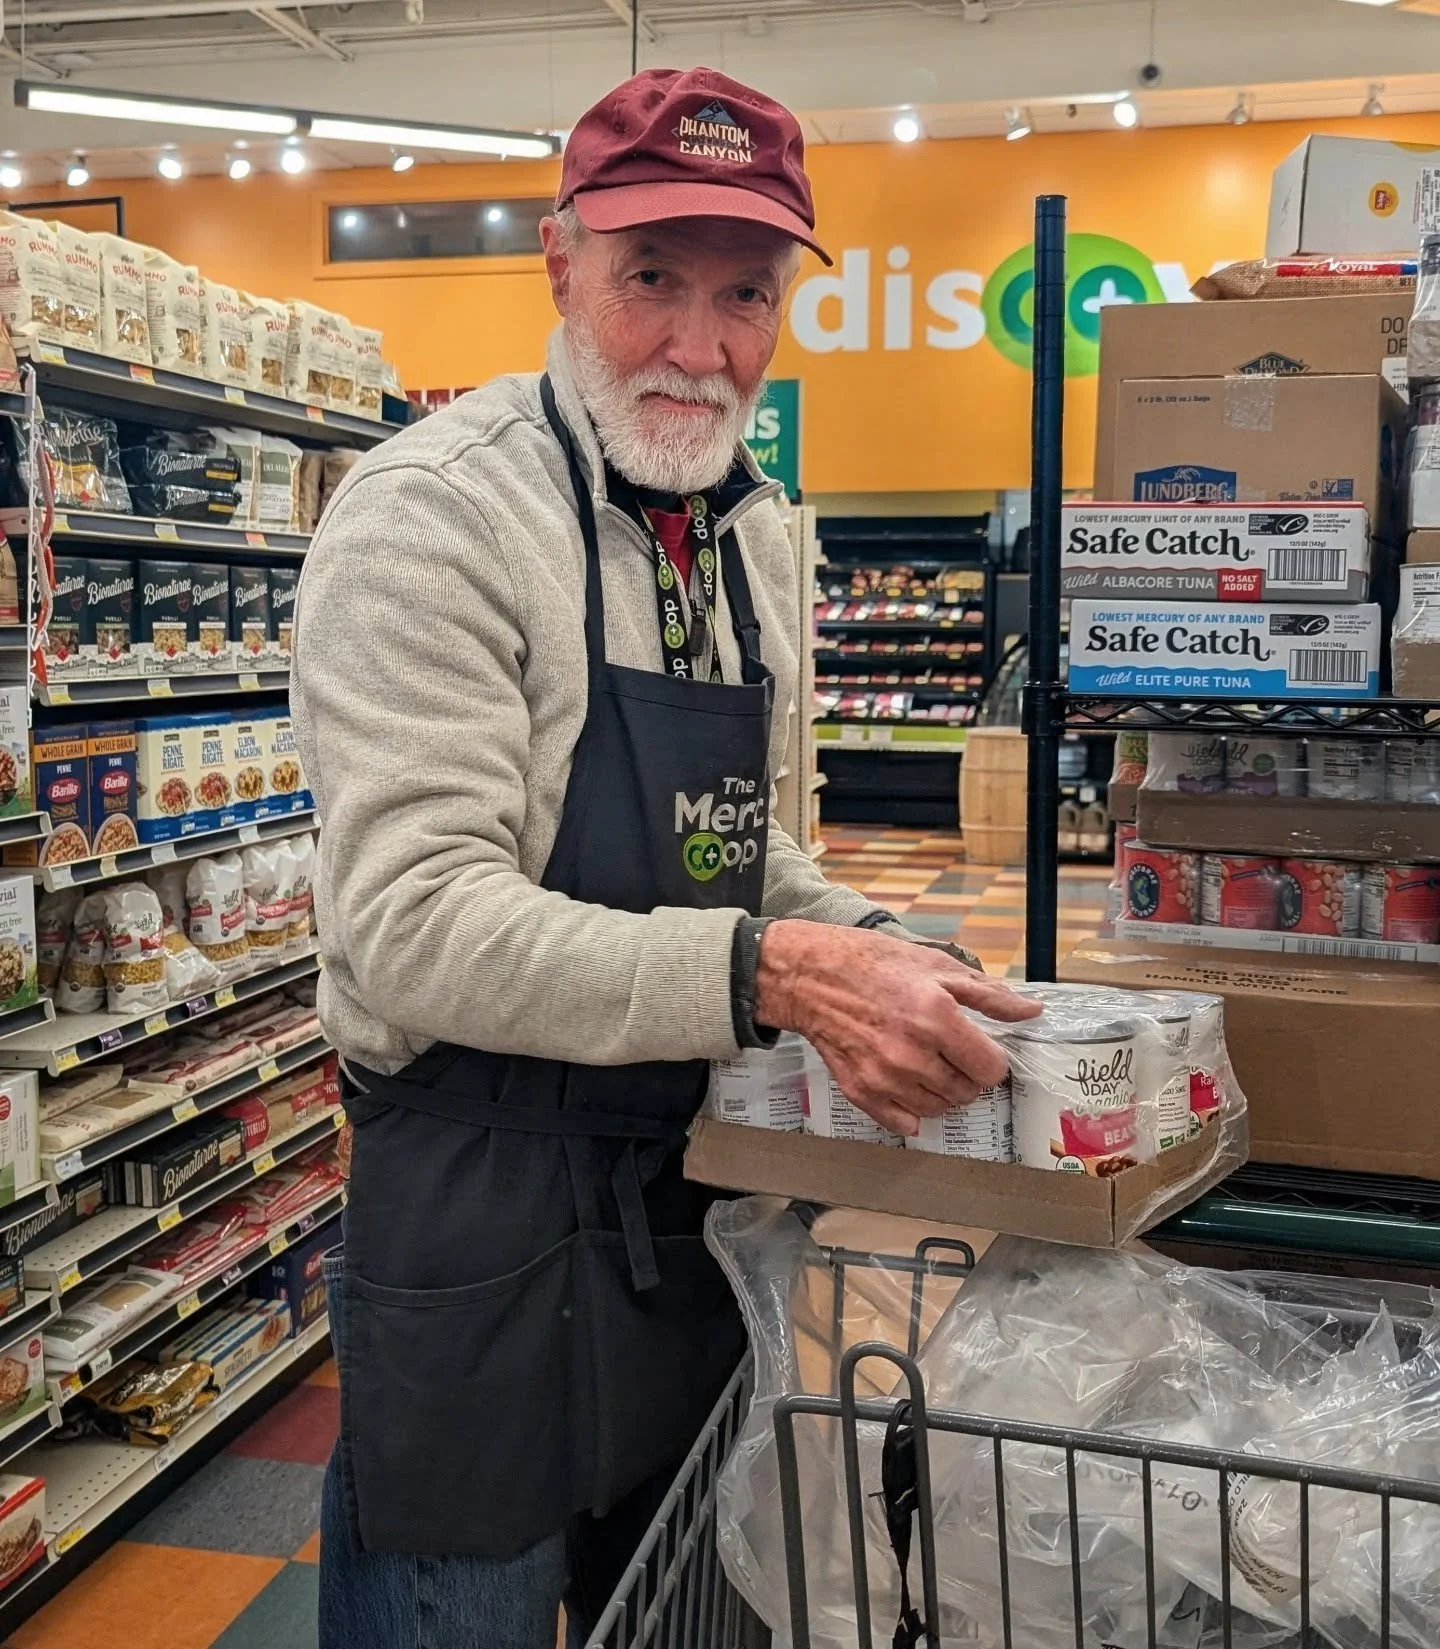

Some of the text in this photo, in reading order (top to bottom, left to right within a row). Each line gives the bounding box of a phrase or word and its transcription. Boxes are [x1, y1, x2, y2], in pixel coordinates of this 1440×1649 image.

[680, 116, 749, 148] PHANTOM
[680, 140, 752, 163] CANYON
[29, 242, 58, 256] RUMM
[66, 254, 98, 273] RUMMO
[113, 265, 142, 285] RUMMO
[1259, 358, 1285, 368] BLUE
[1141, 481, 1228, 500] LUNDBERG
[1074, 515, 1109, 523] LOWEST
[1110, 515, 1152, 523] MERCURY
[1154, 515, 1178, 523] LIMIT
[1180, 515, 1191, 523] OF
[1193, 515, 1212, 523] ANY
[1214, 515, 1245, 523] BRAND
[1066, 527, 1250, 562] Safe Catch
[1063, 572, 1214, 590] Wild ALBACORE TUNA
[1222, 575, 1257, 583] NO SALT
[87, 577, 134, 605] Bionaturae
[144, 578, 191, 605] Bionaturae
[1224, 583, 1254, 591] ADDED
[1092, 612, 1265, 624] LOWEST MERCURY OF ANY BRAND
[1085, 625, 1270, 661] Safe Catch
[1096, 671, 1251, 688] Wild ELITE PURE TUNA
[40, 743, 84, 759] WHOLE GRAIN
[95, 738, 132, 752] WHOLE GRAIN
[163, 744, 182, 757] PENNE
[202, 740, 223, 752] PENNE
[108, 757, 122, 767] PENNE
[163, 755, 184, 770] RIGATE
[202, 751, 224, 765] RIGATE
[56, 764, 72, 774] PENNE
[104, 776, 128, 789] Barilla
[723, 777, 756, 794] The
[52, 783, 78, 798] Barilla
[1186, 967, 1227, 976] THIS
[1233, 972, 1280, 980] SIDE
[1145, 974, 1348, 995] HANDLE WITH CARE
[1065, 1048, 1132, 1096] field
[1091, 1082, 1118, 1096] DAY
[1104, 1127, 1135, 1147] BEA
[163, 1138, 220, 1201] Bionaturae
[1062, 1162, 1080, 1170] USDA
[95, 1358, 109, 1371] new
